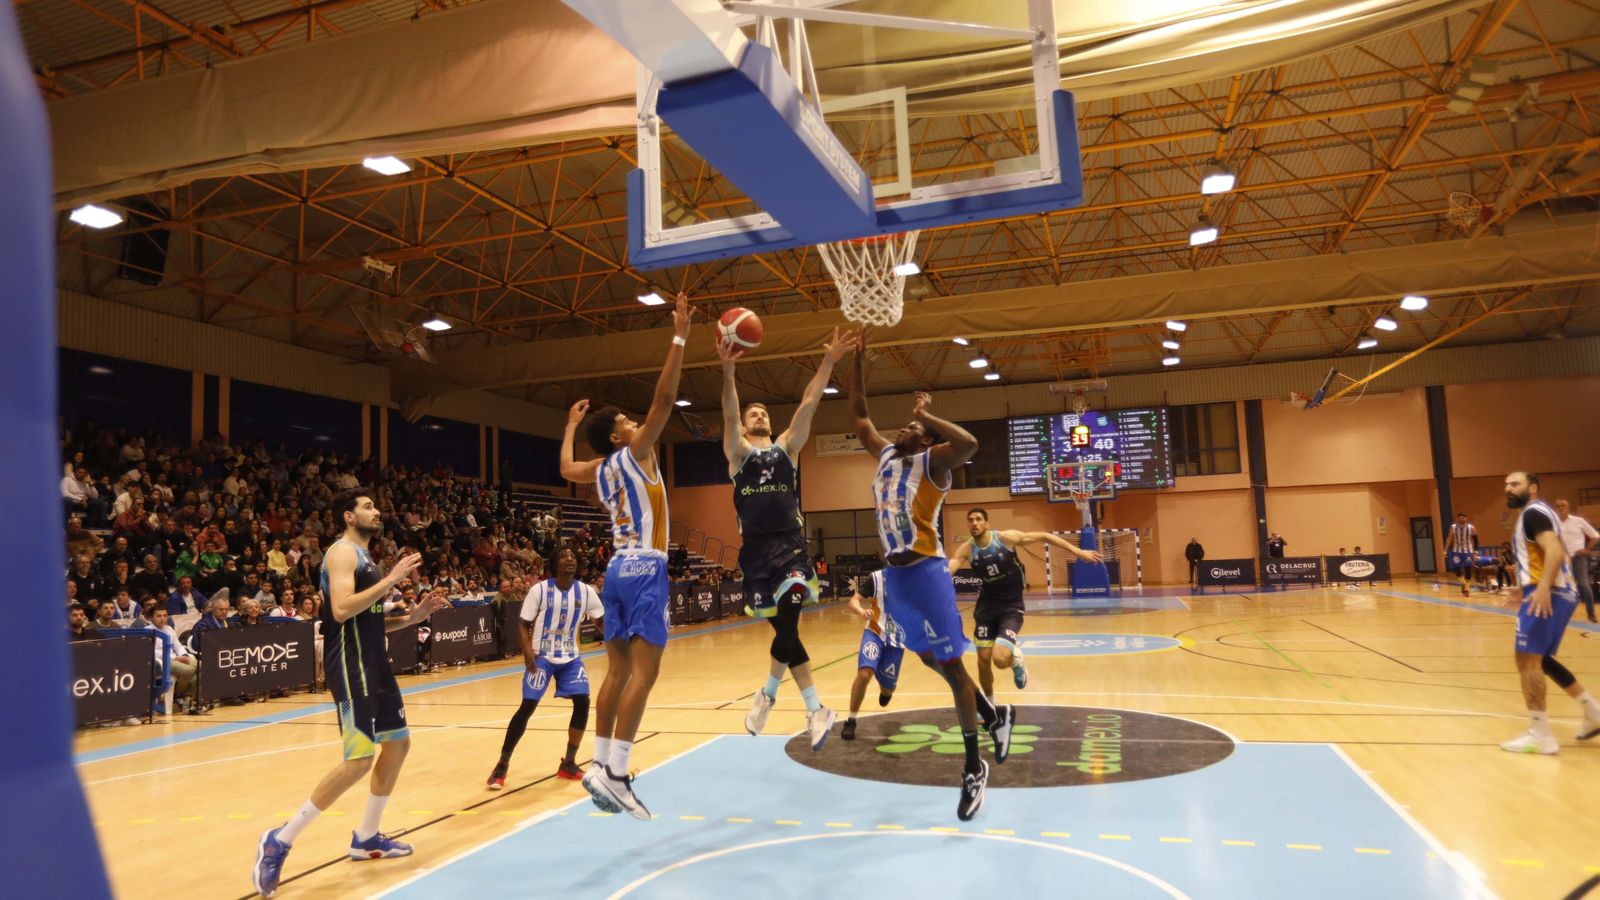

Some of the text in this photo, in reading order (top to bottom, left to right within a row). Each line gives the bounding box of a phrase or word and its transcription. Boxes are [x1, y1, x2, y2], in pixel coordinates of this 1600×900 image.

[1093, 438, 1115, 450] 40
[986, 563, 1000, 576] 21
[473, 632, 492, 643] LABOR
[977, 626, 988, 637] 21
[229, 661, 288, 678] CENTER
